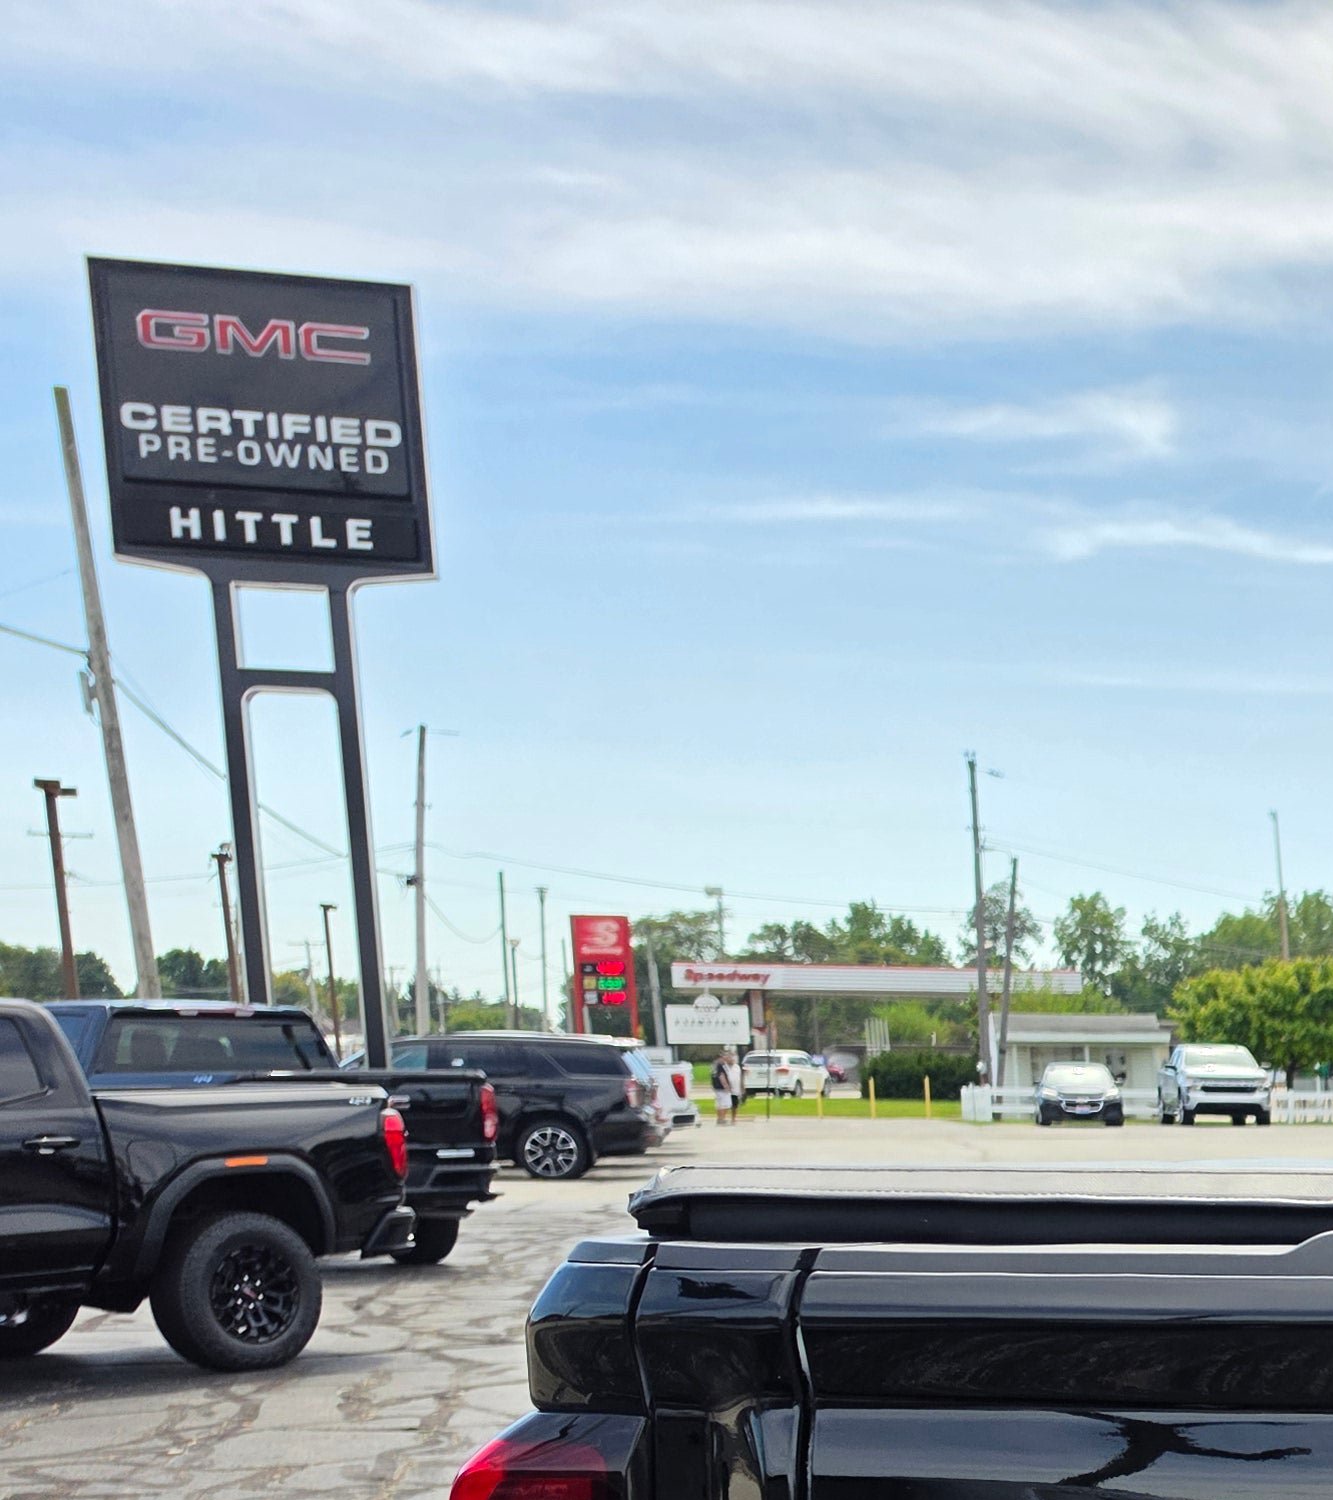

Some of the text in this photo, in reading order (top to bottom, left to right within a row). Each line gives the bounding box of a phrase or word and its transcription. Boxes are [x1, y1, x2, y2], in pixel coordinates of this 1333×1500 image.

[136, 309, 371, 366] GMC
[120, 402, 402, 448] CERTIFIED
[138, 432, 389, 474] PRE-OWNED
[169, 506, 374, 550] HITTLE
